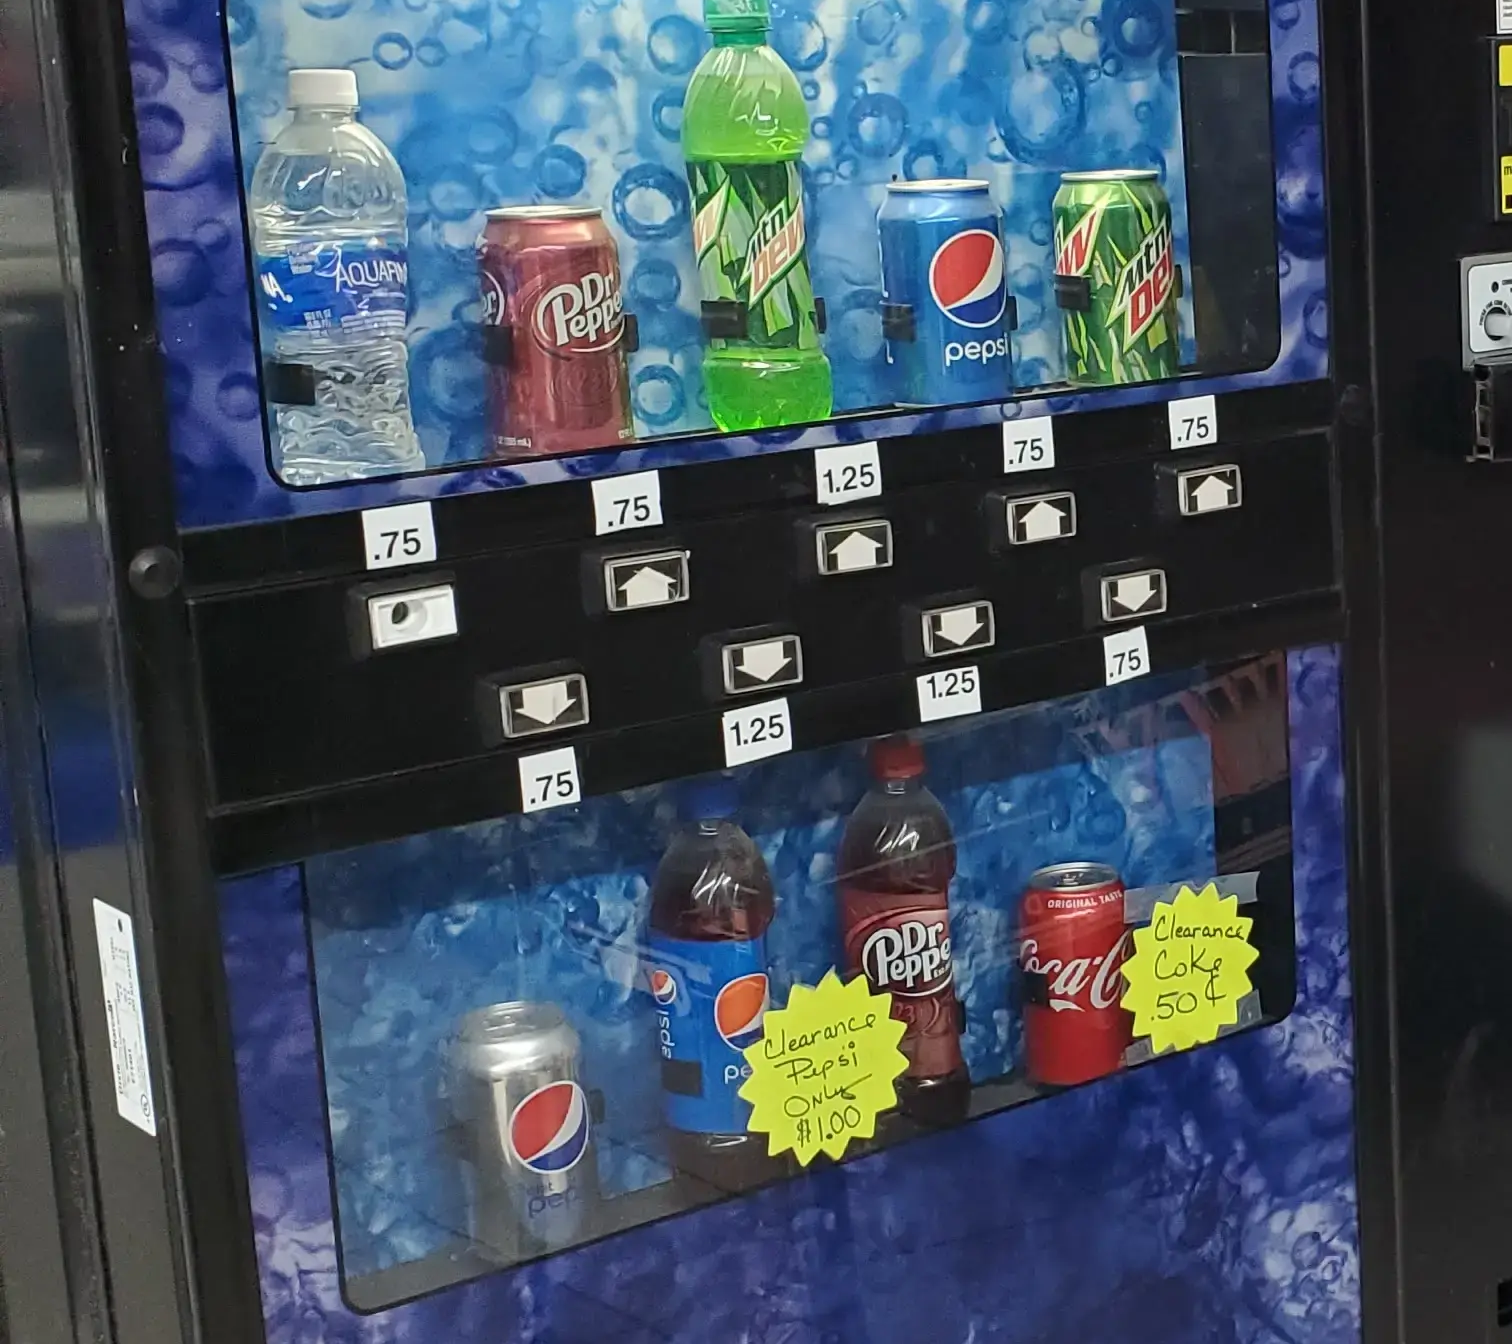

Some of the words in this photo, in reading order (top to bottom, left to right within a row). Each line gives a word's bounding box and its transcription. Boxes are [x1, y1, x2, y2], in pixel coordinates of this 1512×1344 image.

[580, 271, 615, 311] Dr
[537, 283, 624, 347] Peppe
[944, 331, 1009, 367] pepsi
[1175, 415, 1211, 443] .75
[1008, 437, 1045, 465] .75
[822, 462, 876, 494] 1.25
[606, 494, 652, 527] .75
[371, 527, 423, 560] .75
[1108, 647, 1143, 678] .75
[925, 667, 978, 699] 1.25
[729, 712, 787, 748] 1.25
[529, 770, 575, 805] .75
[1047, 897, 1099, 909] ORIGINAL
[900, 921, 944, 957] Dr
[1154, 913, 1245, 942] Clearance
[861, 928, 952, 989] Peppe
[656, 1009, 676, 1059] epsi
[764, 1013, 877, 1060] Clearance
[773, 1040, 859, 1086] Pepsi
[797, 1105, 862, 1148] $1.00
